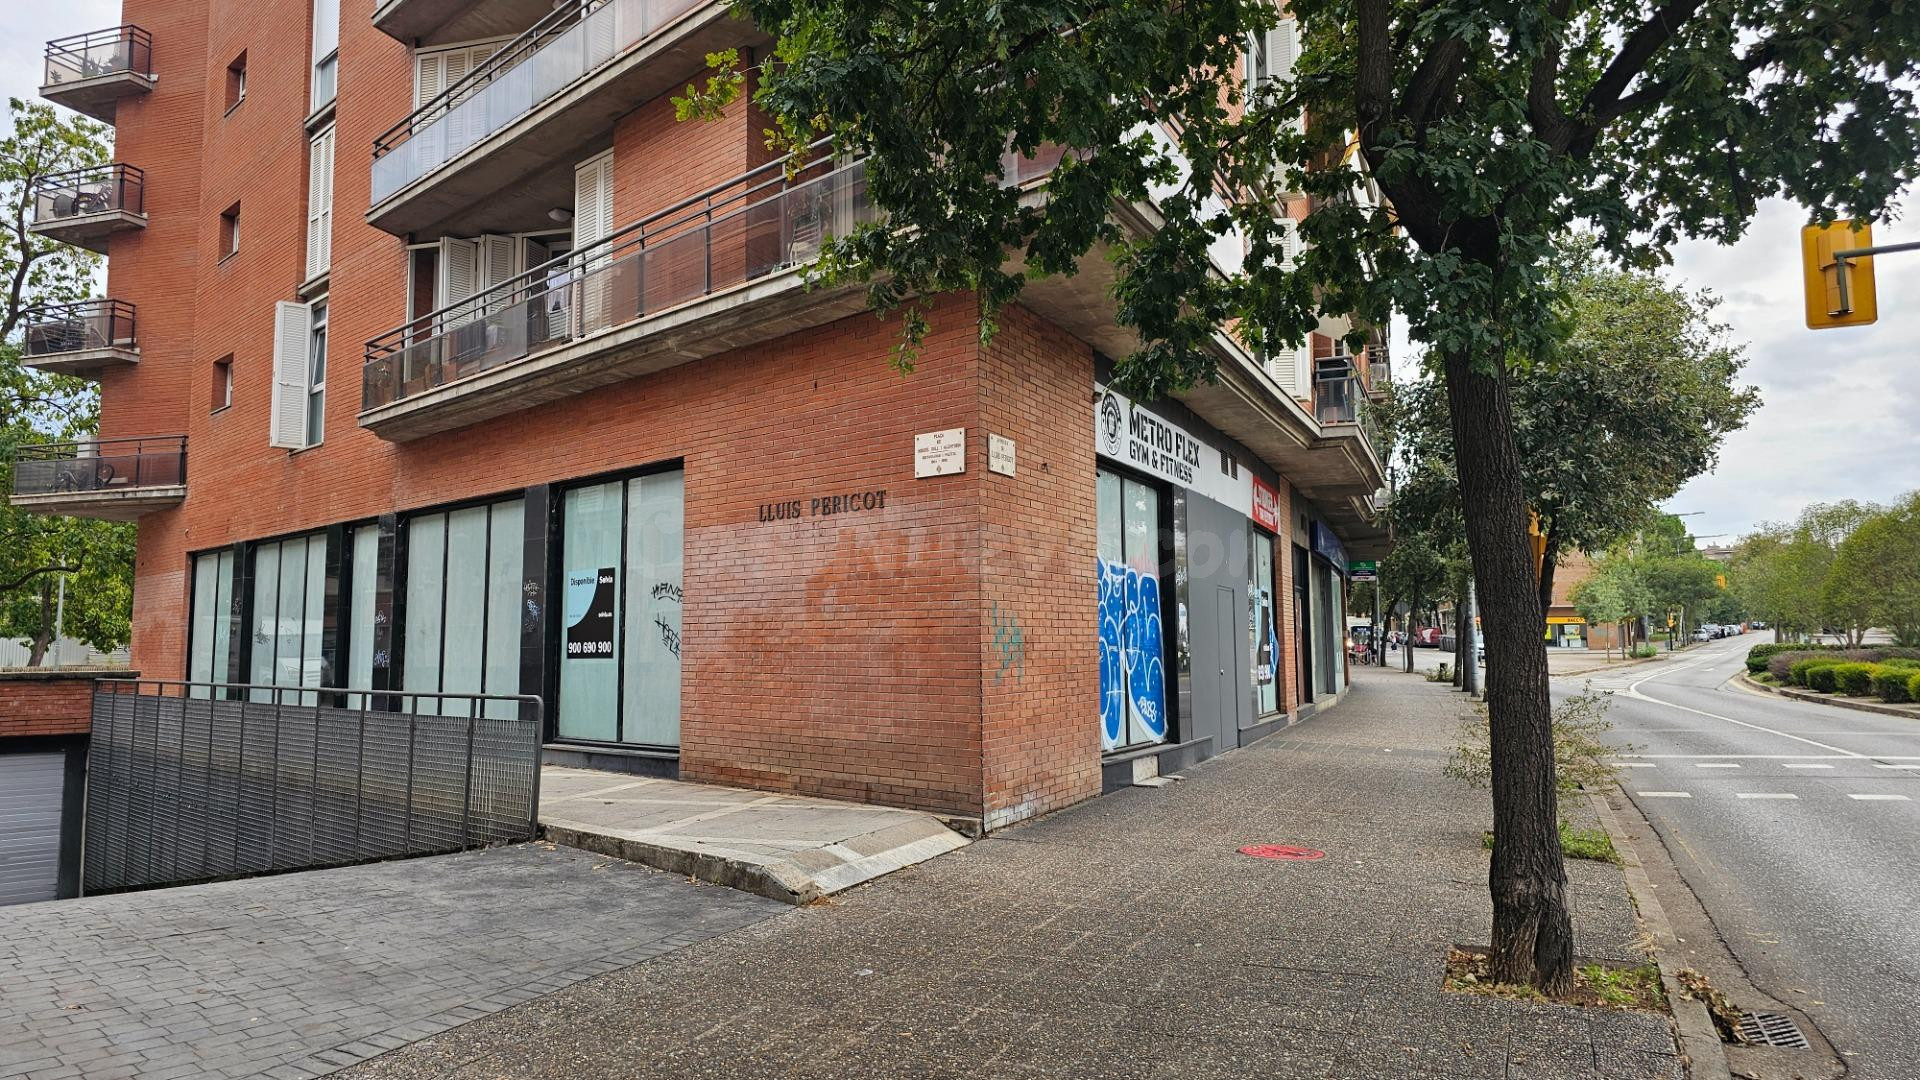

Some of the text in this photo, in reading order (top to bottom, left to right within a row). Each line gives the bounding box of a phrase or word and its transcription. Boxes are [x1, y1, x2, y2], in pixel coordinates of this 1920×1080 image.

[1129, 407, 1172, 453] METRO
[1176, 433, 1200, 468] FLEX
[1130, 439, 1193, 484] GYM & FITNESS
[758, 489, 887, 522] LLUIS PERICOT
[568, 641, 612, 653] 900 690 900
